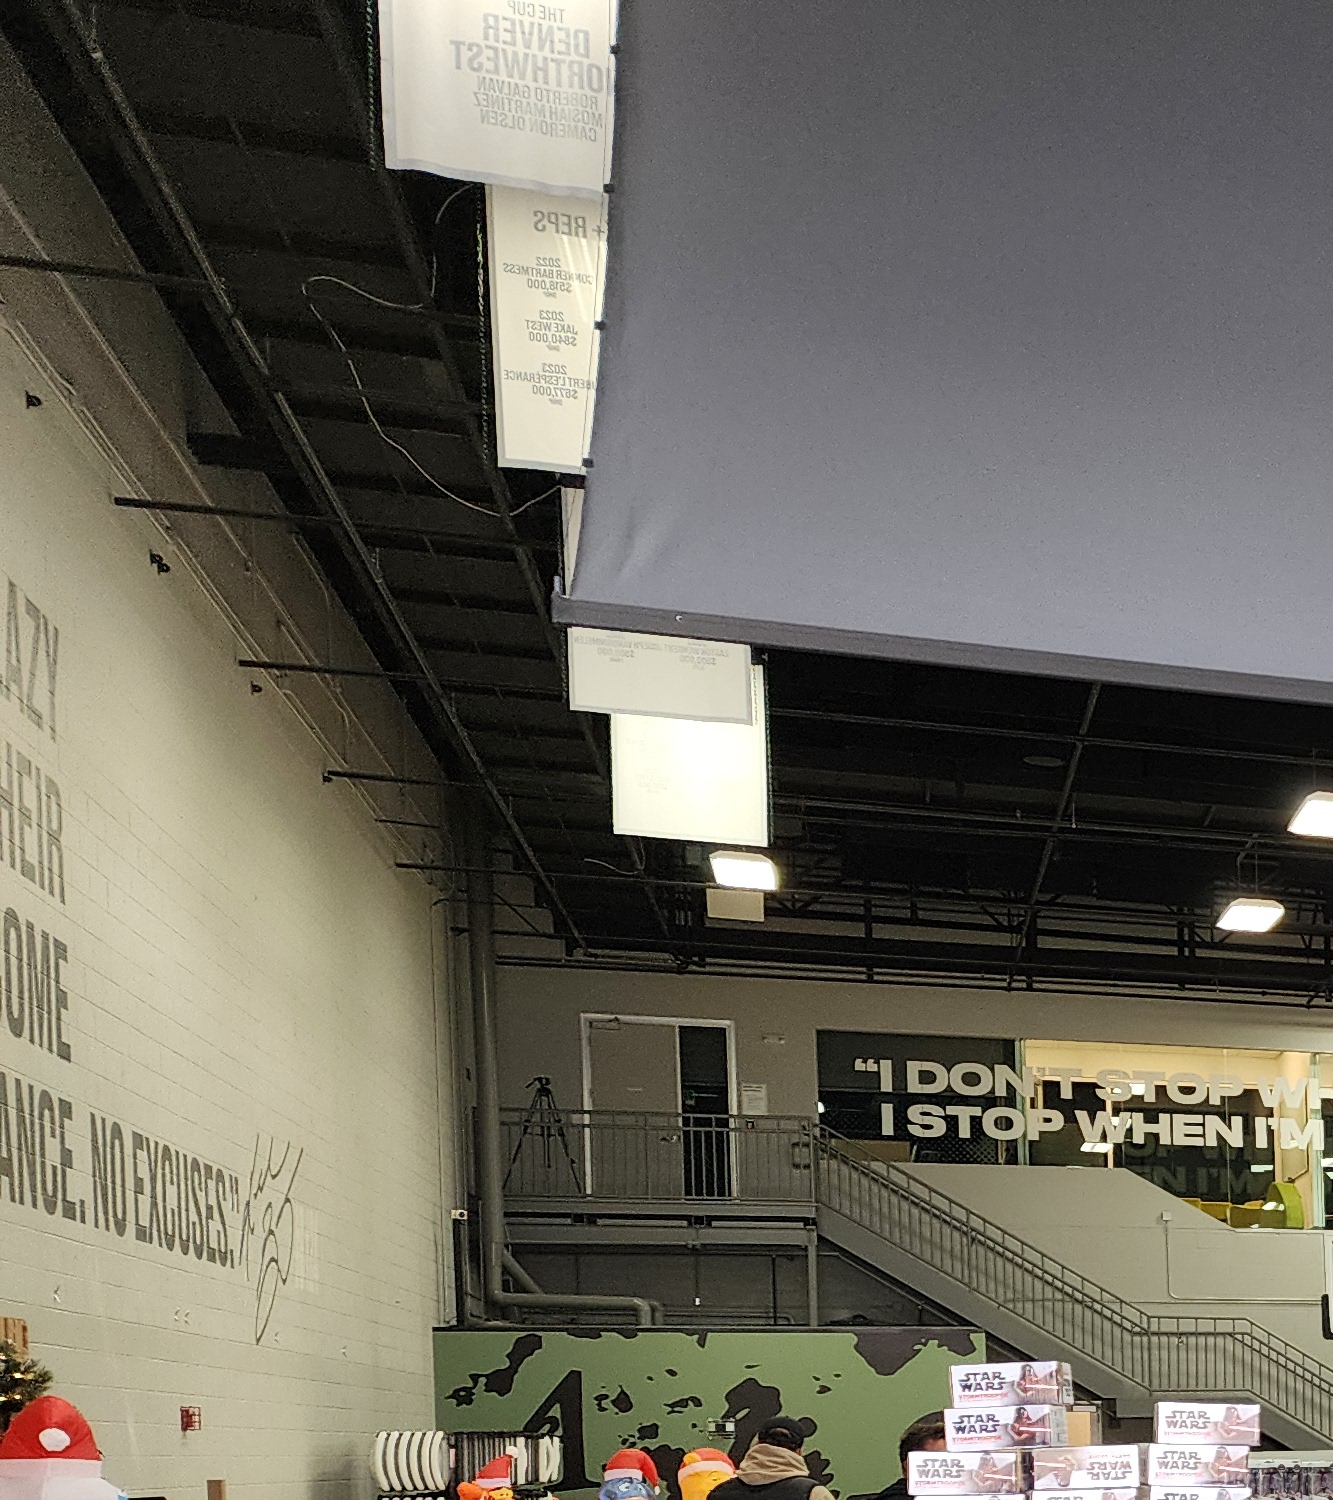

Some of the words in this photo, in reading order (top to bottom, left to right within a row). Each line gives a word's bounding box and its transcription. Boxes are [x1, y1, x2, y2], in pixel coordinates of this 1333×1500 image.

[1095, 1068, 1245, 1106] STOP
[881, 1103, 894, 1136] I
[906, 1104, 1065, 1141] STOP
[1074, 1109, 1244, 1148] WHEN
[1255, 1117, 1325, 1152] I'M
[90, 1107, 128, 1238] NO
[958, 1372, 1007, 1382] STAR
[959, 1382, 1007, 1392] WARS
[952, 1414, 1000, 1424] STAR
[1165, 1410, 1211, 1420] STAR
[953, 1424, 1000, 1434] WARS
[1165, 1420, 1211, 1430] WARS
[1156, 1451, 1201, 1460] STAR
[916, 1459, 965, 1468] STAR
[1157, 1460, 1202, 1470] WARS
[916, 1468, 965, 1479] WARS
